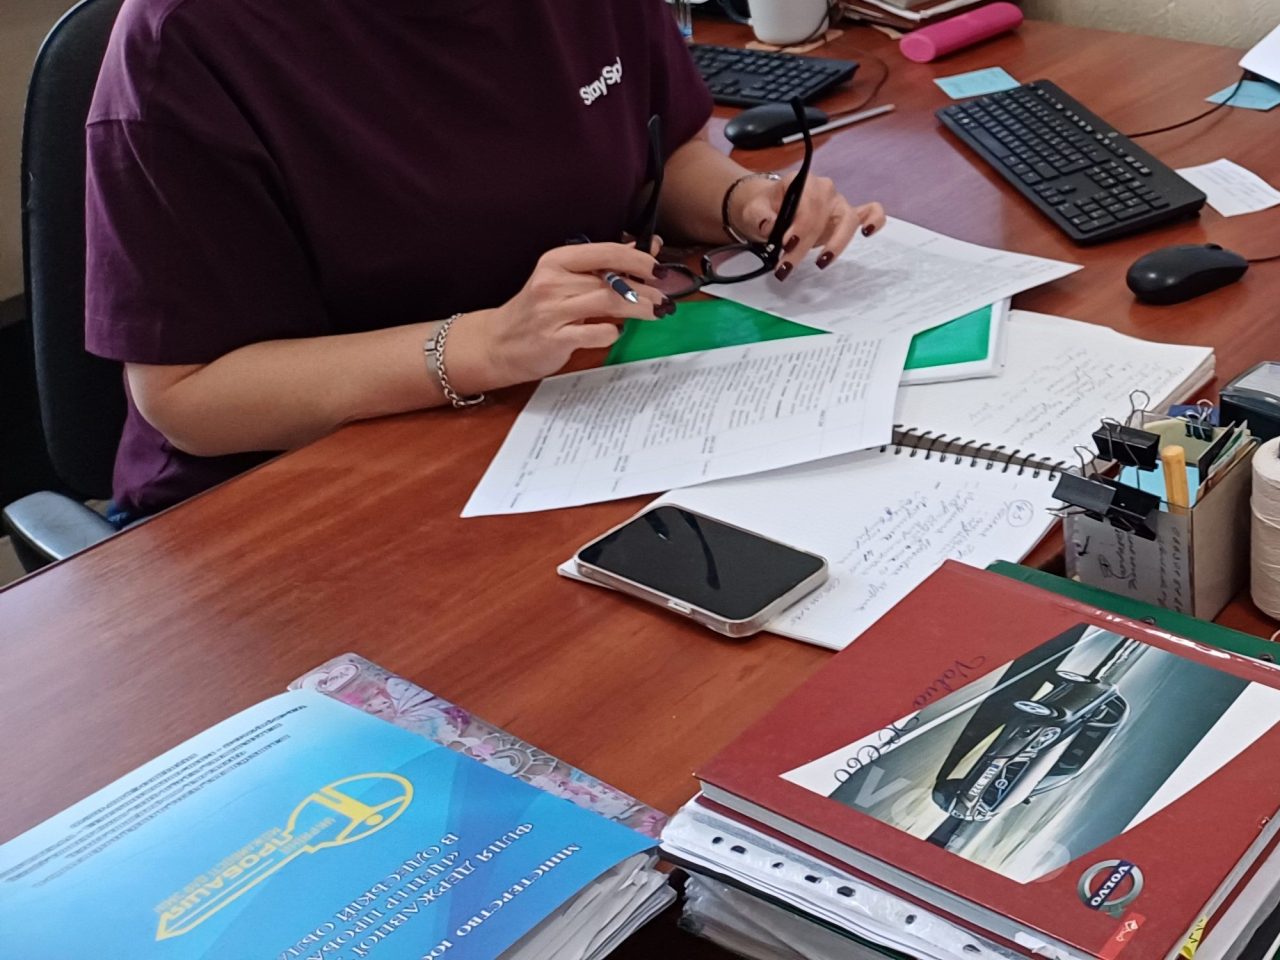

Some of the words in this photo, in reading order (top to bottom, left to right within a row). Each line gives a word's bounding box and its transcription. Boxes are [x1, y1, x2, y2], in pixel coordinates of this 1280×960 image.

[475, 822, 534, 862] ФІЛІЯ
[336, 846, 441, 922] ОДЕСЬКІЙ
[351, 859, 476, 957] ДЕРЖАВНОЇ
[456, 843, 582, 936] МІНІСТЕРСТВО
[1090, 865, 1130, 906] VOLVO
